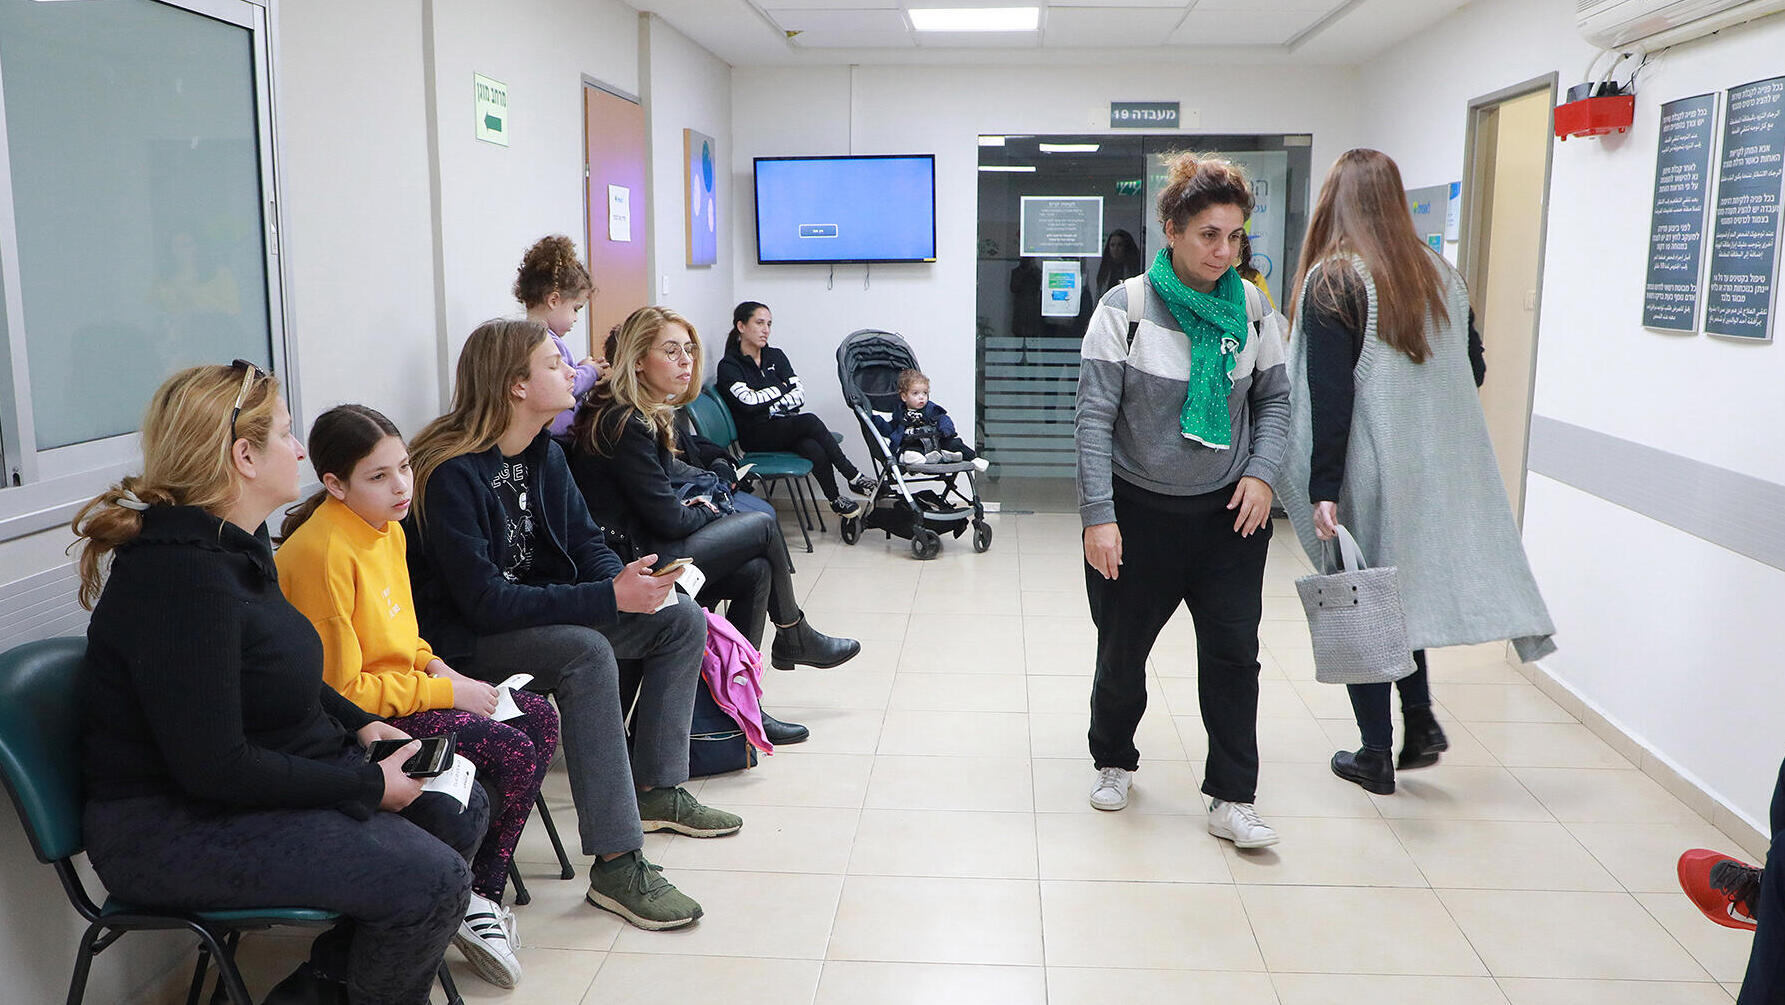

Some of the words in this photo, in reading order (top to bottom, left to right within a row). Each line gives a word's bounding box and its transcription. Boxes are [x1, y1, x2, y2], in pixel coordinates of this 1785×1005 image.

[477, 82, 489, 102] מוגן
[491, 87, 506, 108] מרחב
[1113, 108, 1129, 119] 19
[1132, 109, 1176, 120] מעבדה
[1764, 193, 1775, 202] בכל
[1750, 273, 1765, 283] טיפול
